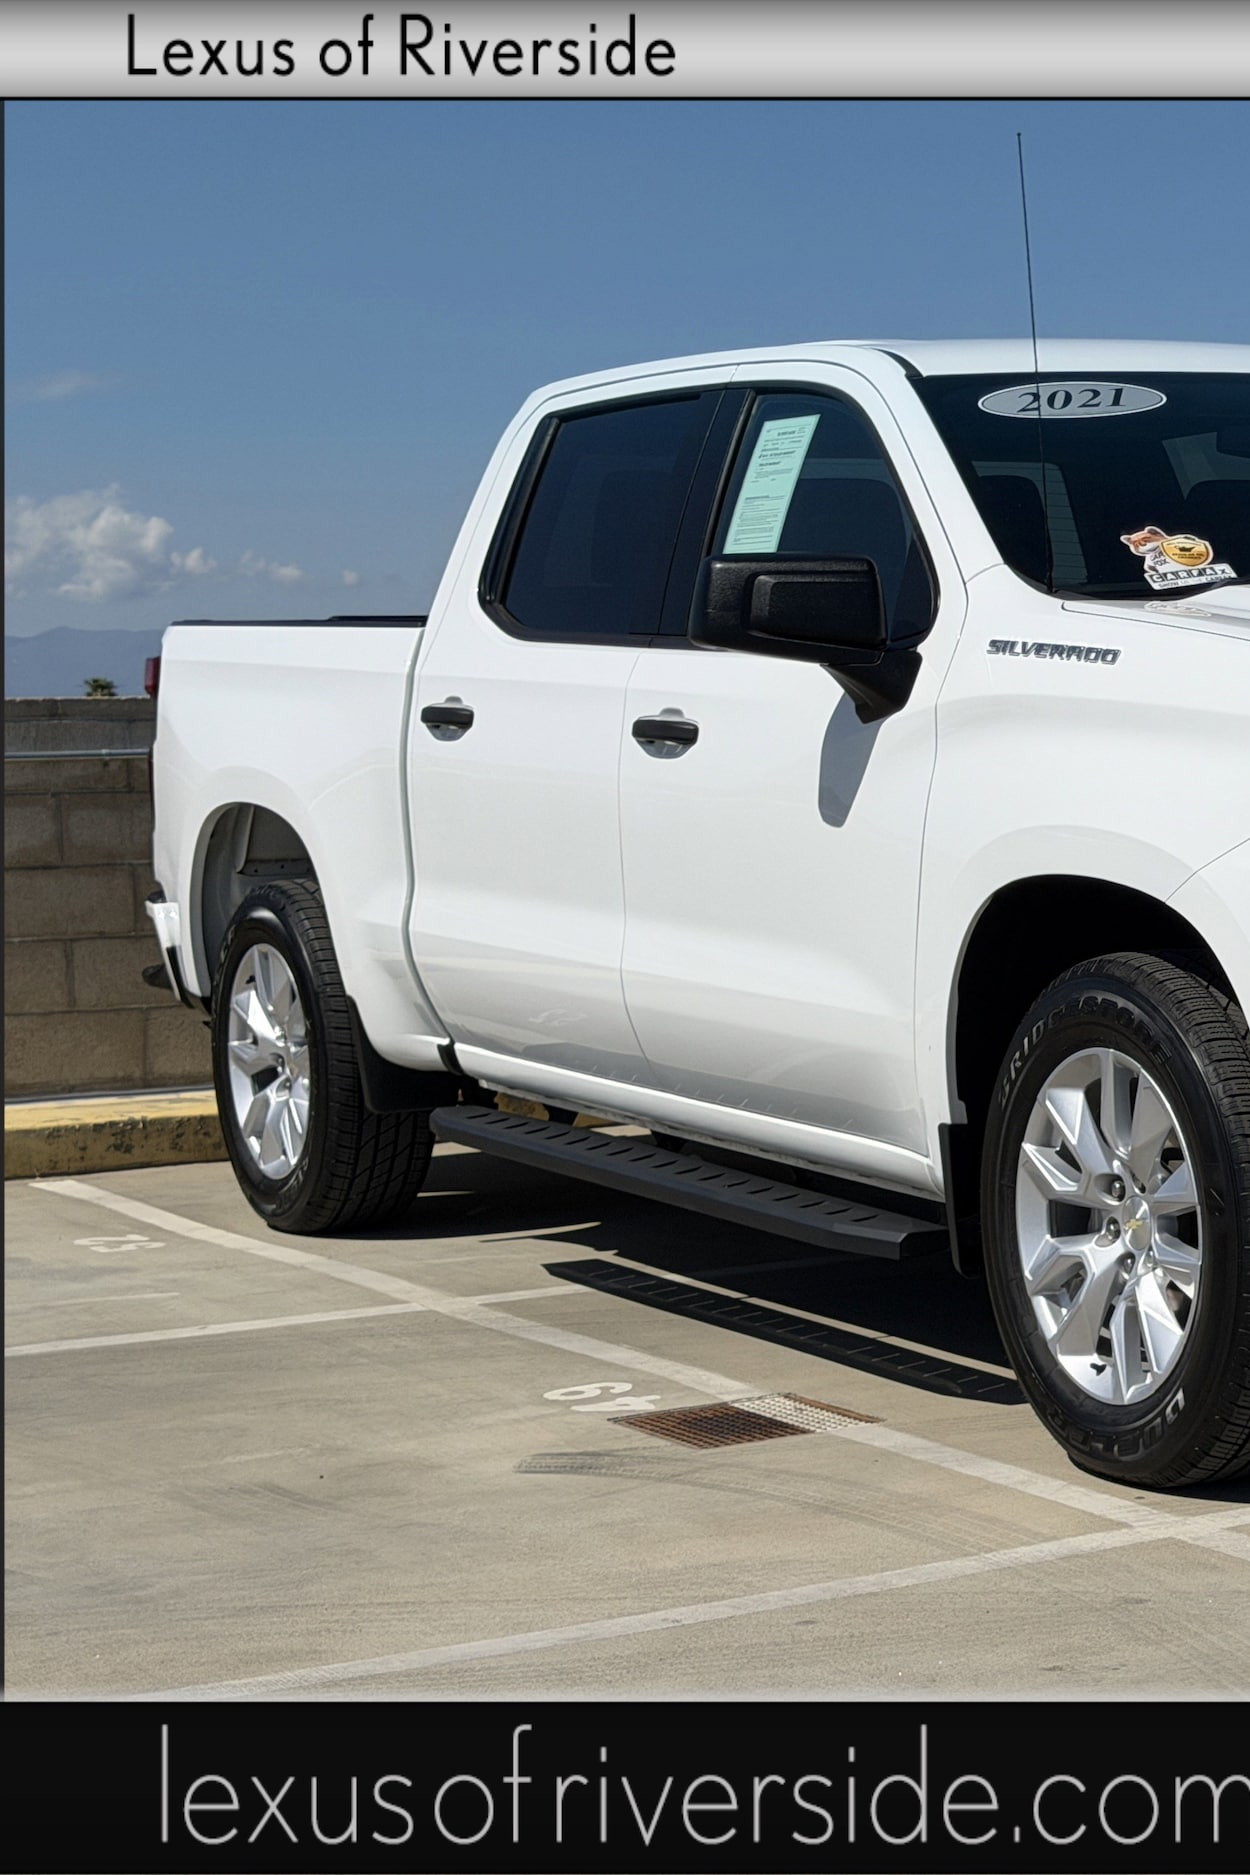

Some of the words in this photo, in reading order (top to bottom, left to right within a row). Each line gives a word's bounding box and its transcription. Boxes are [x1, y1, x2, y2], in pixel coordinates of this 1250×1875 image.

[1017, 387, 1128, 413] 2021
[1151, 567, 1230, 583] CARFAX
[987, 639, 1121, 665] SILVERADO
